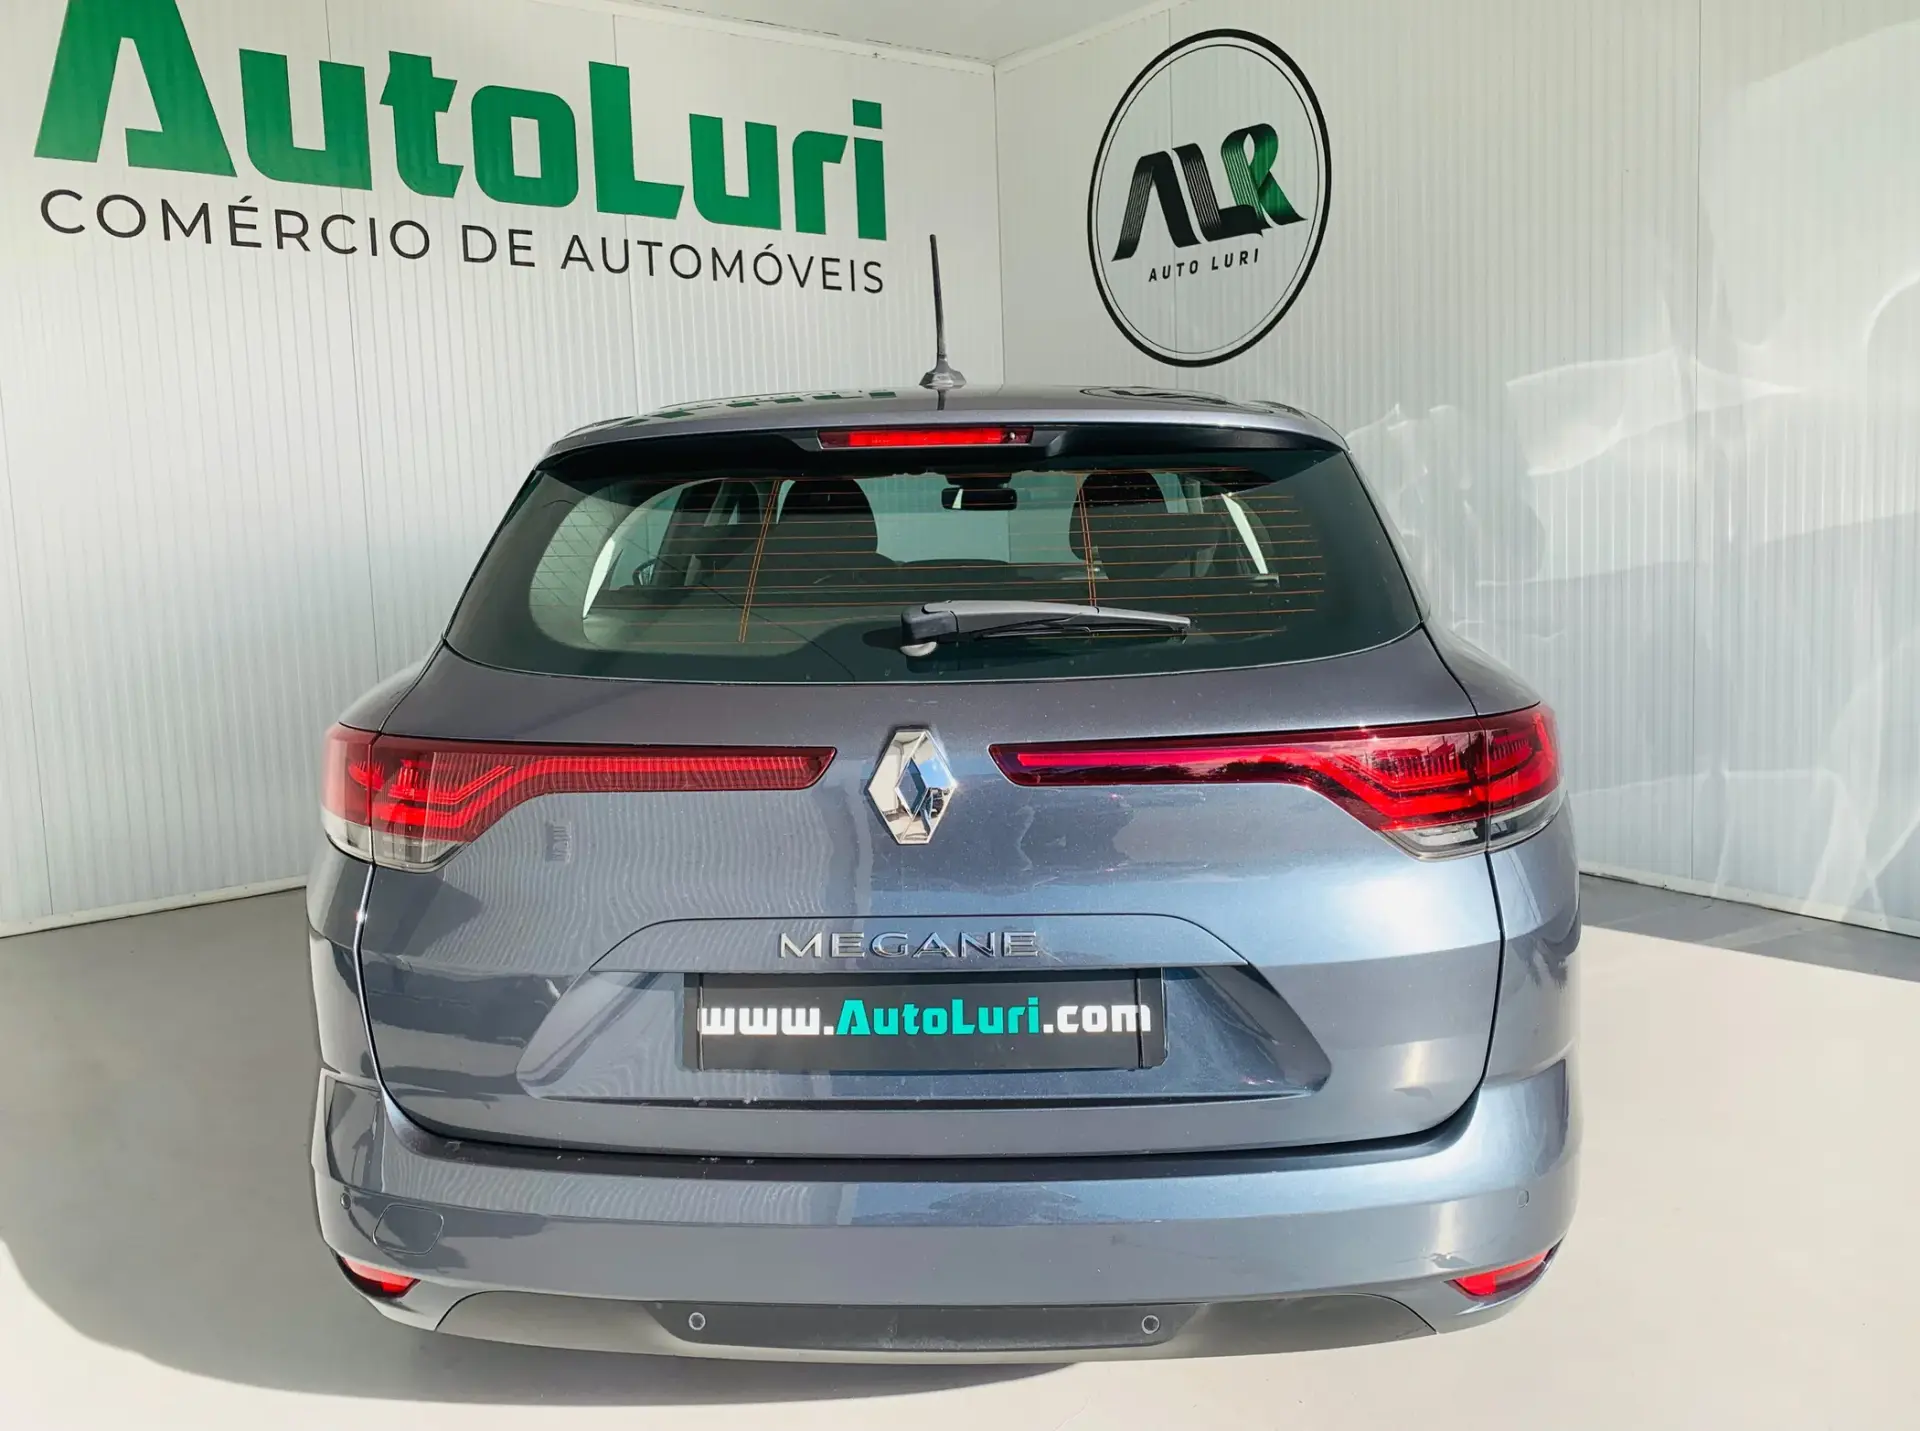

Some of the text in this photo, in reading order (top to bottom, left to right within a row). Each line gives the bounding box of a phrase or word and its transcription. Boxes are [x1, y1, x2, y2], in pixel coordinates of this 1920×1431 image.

[34, 0, 887, 241] AutoLuri
[40, 188, 884, 294] COMÉRCIO DE AUTOMÓVEIS
[1148, 248, 1259, 282] AUTO LURI
[779, 930, 1040, 959] MEGANE
[697, 996, 1152, 1036] www.AutoLuri.com
